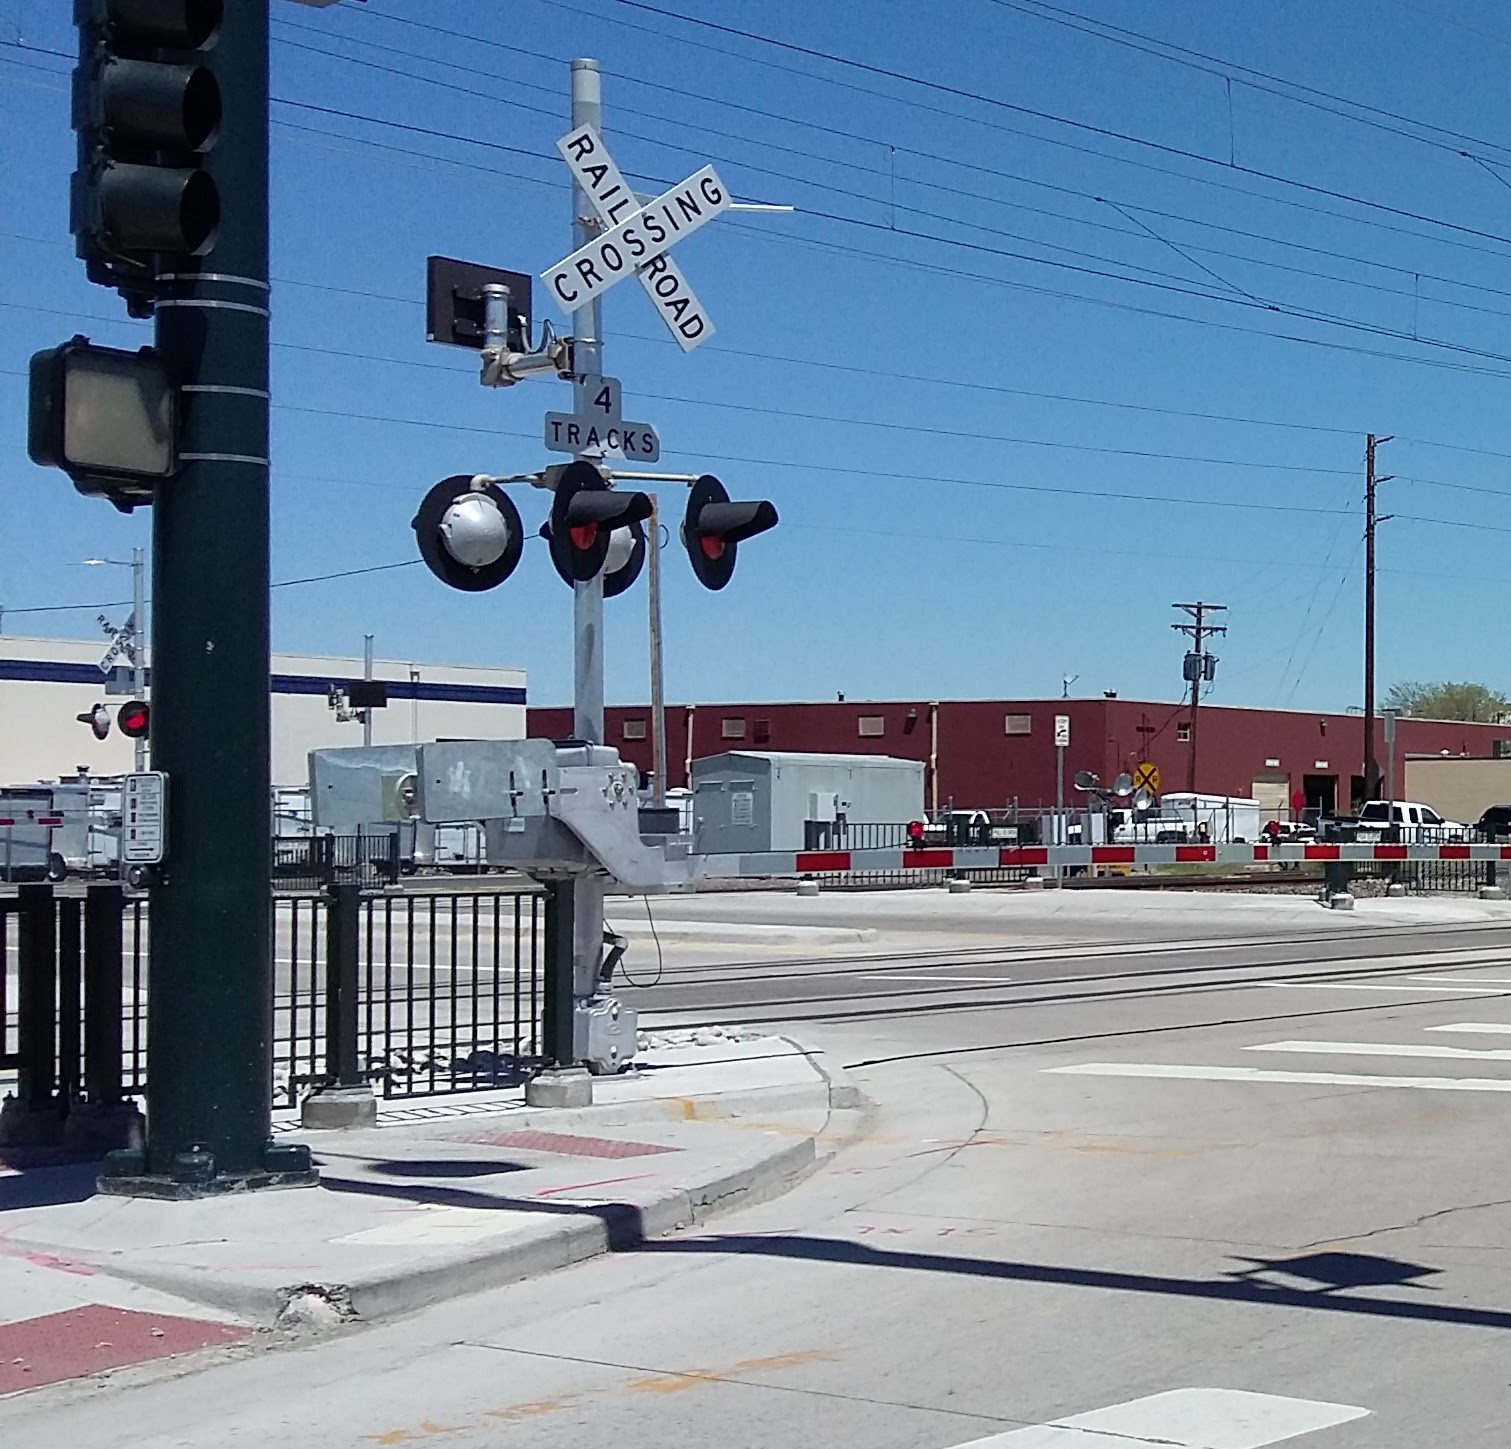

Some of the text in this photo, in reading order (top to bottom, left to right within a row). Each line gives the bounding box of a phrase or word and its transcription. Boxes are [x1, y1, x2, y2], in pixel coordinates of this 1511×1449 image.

[554, 177, 722, 302] CROSSING
[567, 133, 704, 339] RAIL ROAD
[551, 421, 654, 453] TRACKS
[594, 386, 612, 414] 4
